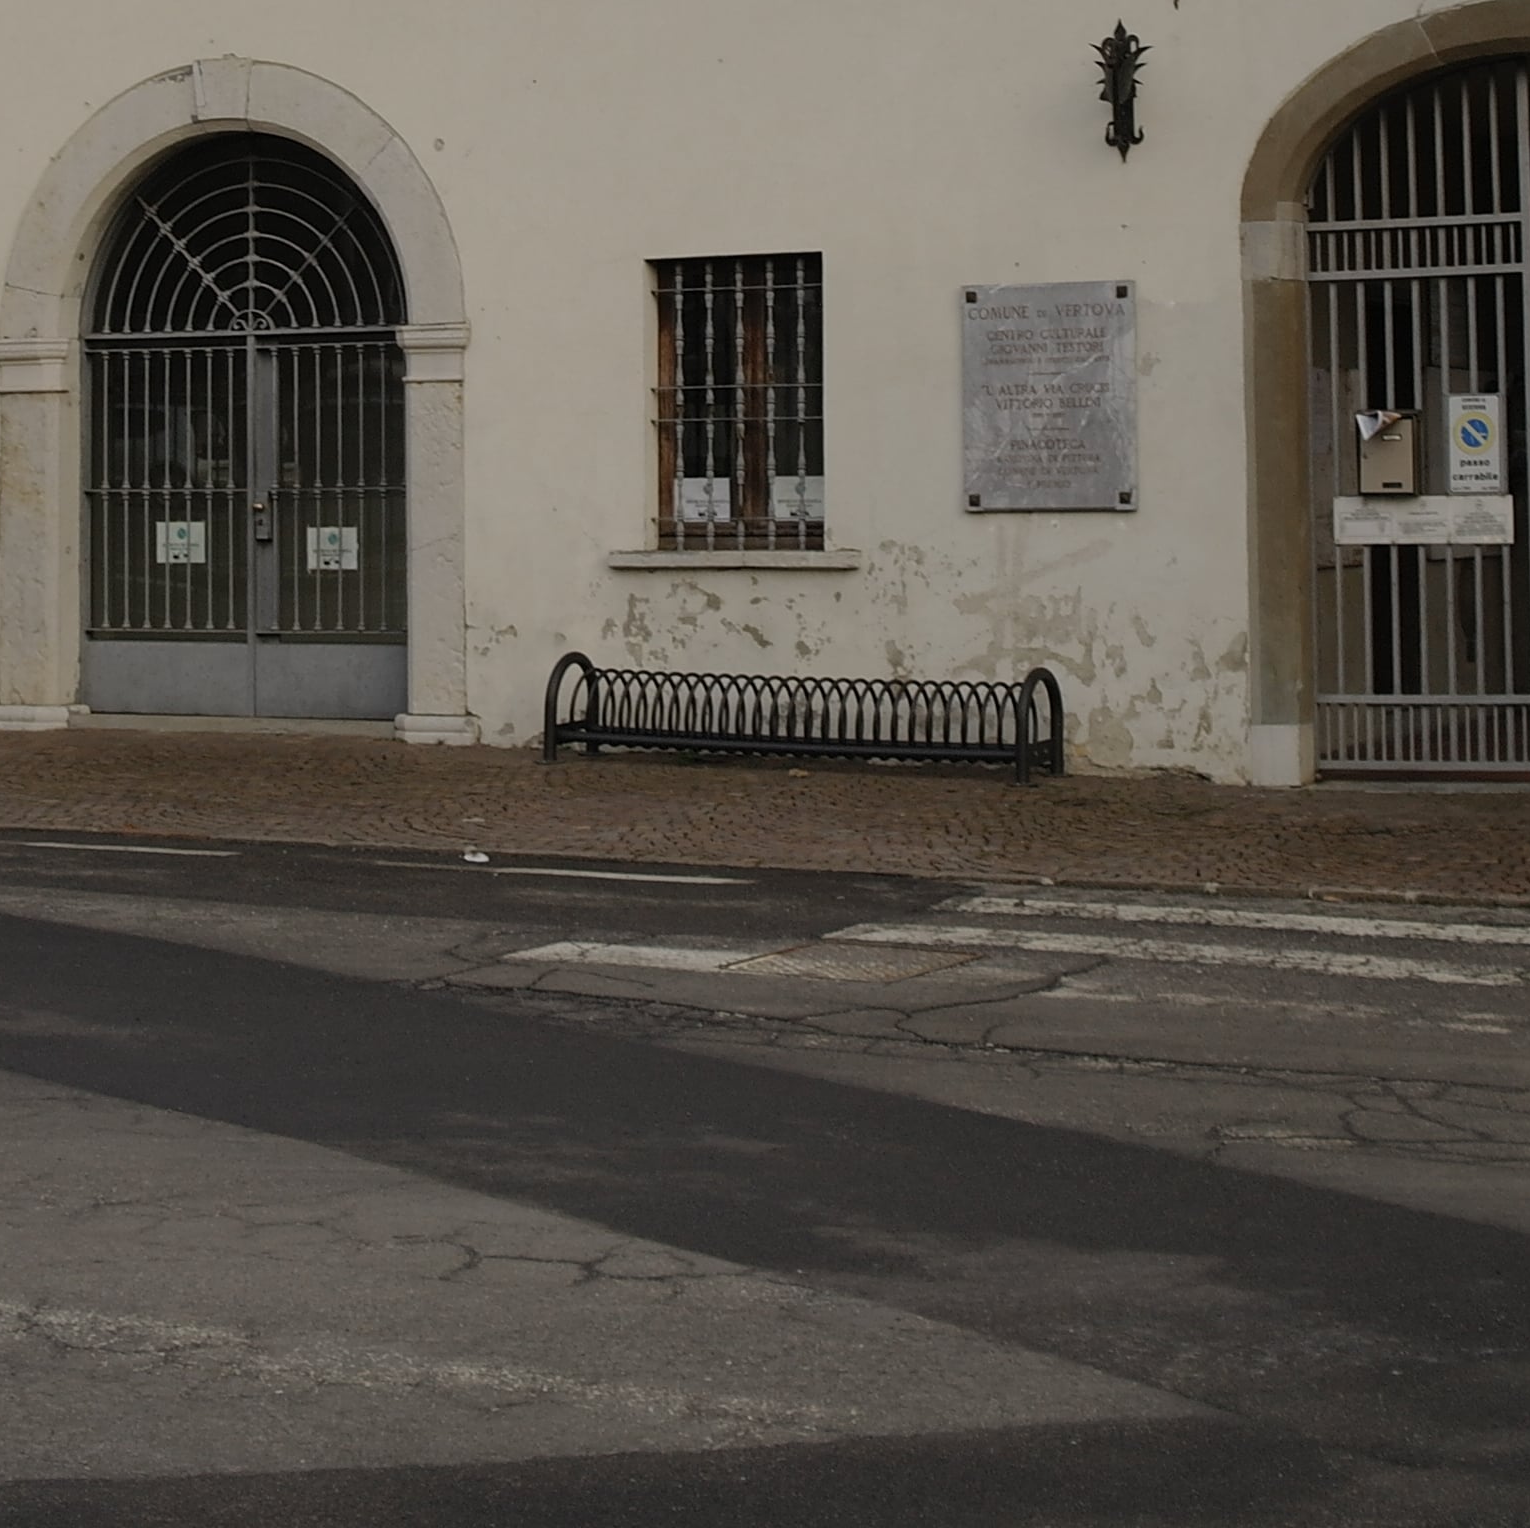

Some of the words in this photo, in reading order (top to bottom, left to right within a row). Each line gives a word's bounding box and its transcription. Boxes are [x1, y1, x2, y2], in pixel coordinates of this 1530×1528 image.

[968, 305, 1030, 321] COMUNE
[1054, 302, 1126, 318] VERTOVA
[987, 329, 1034, 341] CENTRO
[1039, 327, 1106, 340] CULTURALE
[990, 343, 1047, 354] GIOVANNI
[1056, 341, 1104, 353] TESTORI
[995, 398, 1053, 410] VITTORIO
[1058, 397, 1101, 408] BELLINI
[1010, 438, 1086, 450] PINACOTECA
[1459, 459, 1491, 468] passo
[1452, 471, 1498, 481] carrabile
